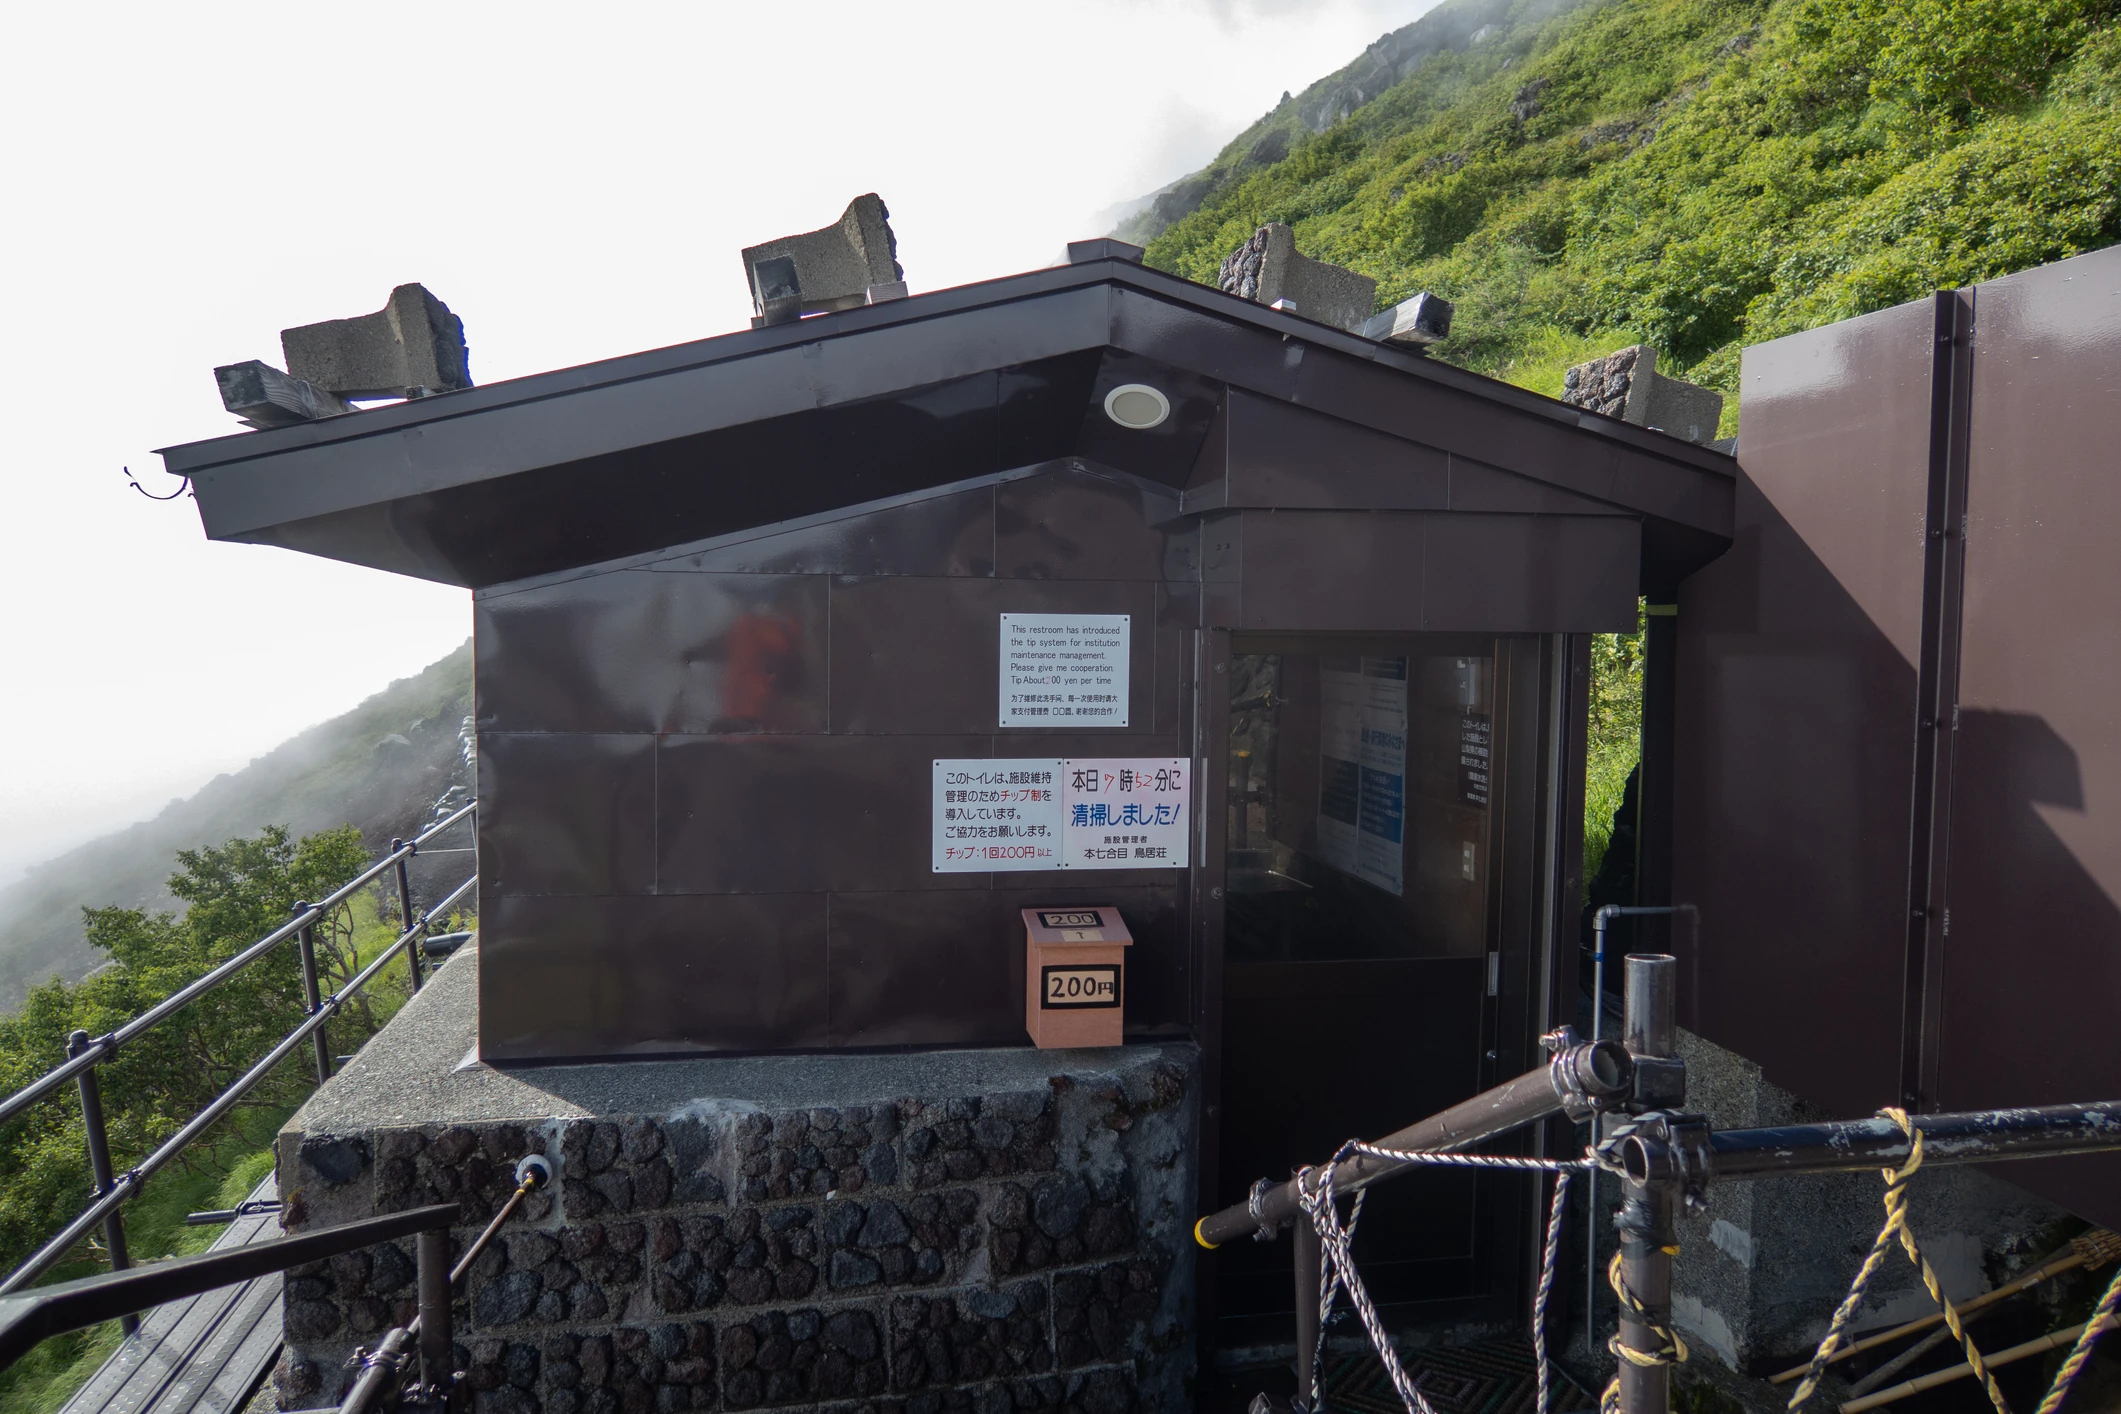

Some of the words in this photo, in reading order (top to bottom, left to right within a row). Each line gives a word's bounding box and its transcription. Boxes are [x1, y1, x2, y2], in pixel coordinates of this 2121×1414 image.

[1011, 625, 1026, 634] This
[1030, 626, 1063, 634] restroom
[1066, 626, 1079, 634] has
[1082, 626, 1120, 635] introduced
[1011, 638, 1023, 646] the
[1027, 638, 1036, 648] tip
[1040, 639, 1066, 648] system
[1070, 638, 1081, 646] for
[1084, 638, 1120, 647] institution
[1010, 651, 1056, 660] maintenance
[1060, 652, 1106, 660] management.
[1010, 663, 1034, 672] Please
[1038, 664, 1053, 673] give
[1070, 664, 1114, 673] cooperation.
[1011, 676, 1022, 685] Tip
[1064, 677, 1078, 686] yen
[1080, 678, 1092, 686] per
[1096, 676, 1112, 684] time
[946, 772, 1052, 784] このトイレは、施設維持
[946, 789, 1052, 802] 管理のためチップ制を
[946, 808, 1021, 820] 導入しています。
[946, 824, 1052, 838] ご協力をお願いします。
[1104, 836, 1148, 844] 施設管理者
[1084, 848, 1128, 860] 本七合目
[1134, 847, 1167, 859] 鳥居荘
[1051, 915, 1094, 924] 200
[1050, 976, 1114, 998] 200円
